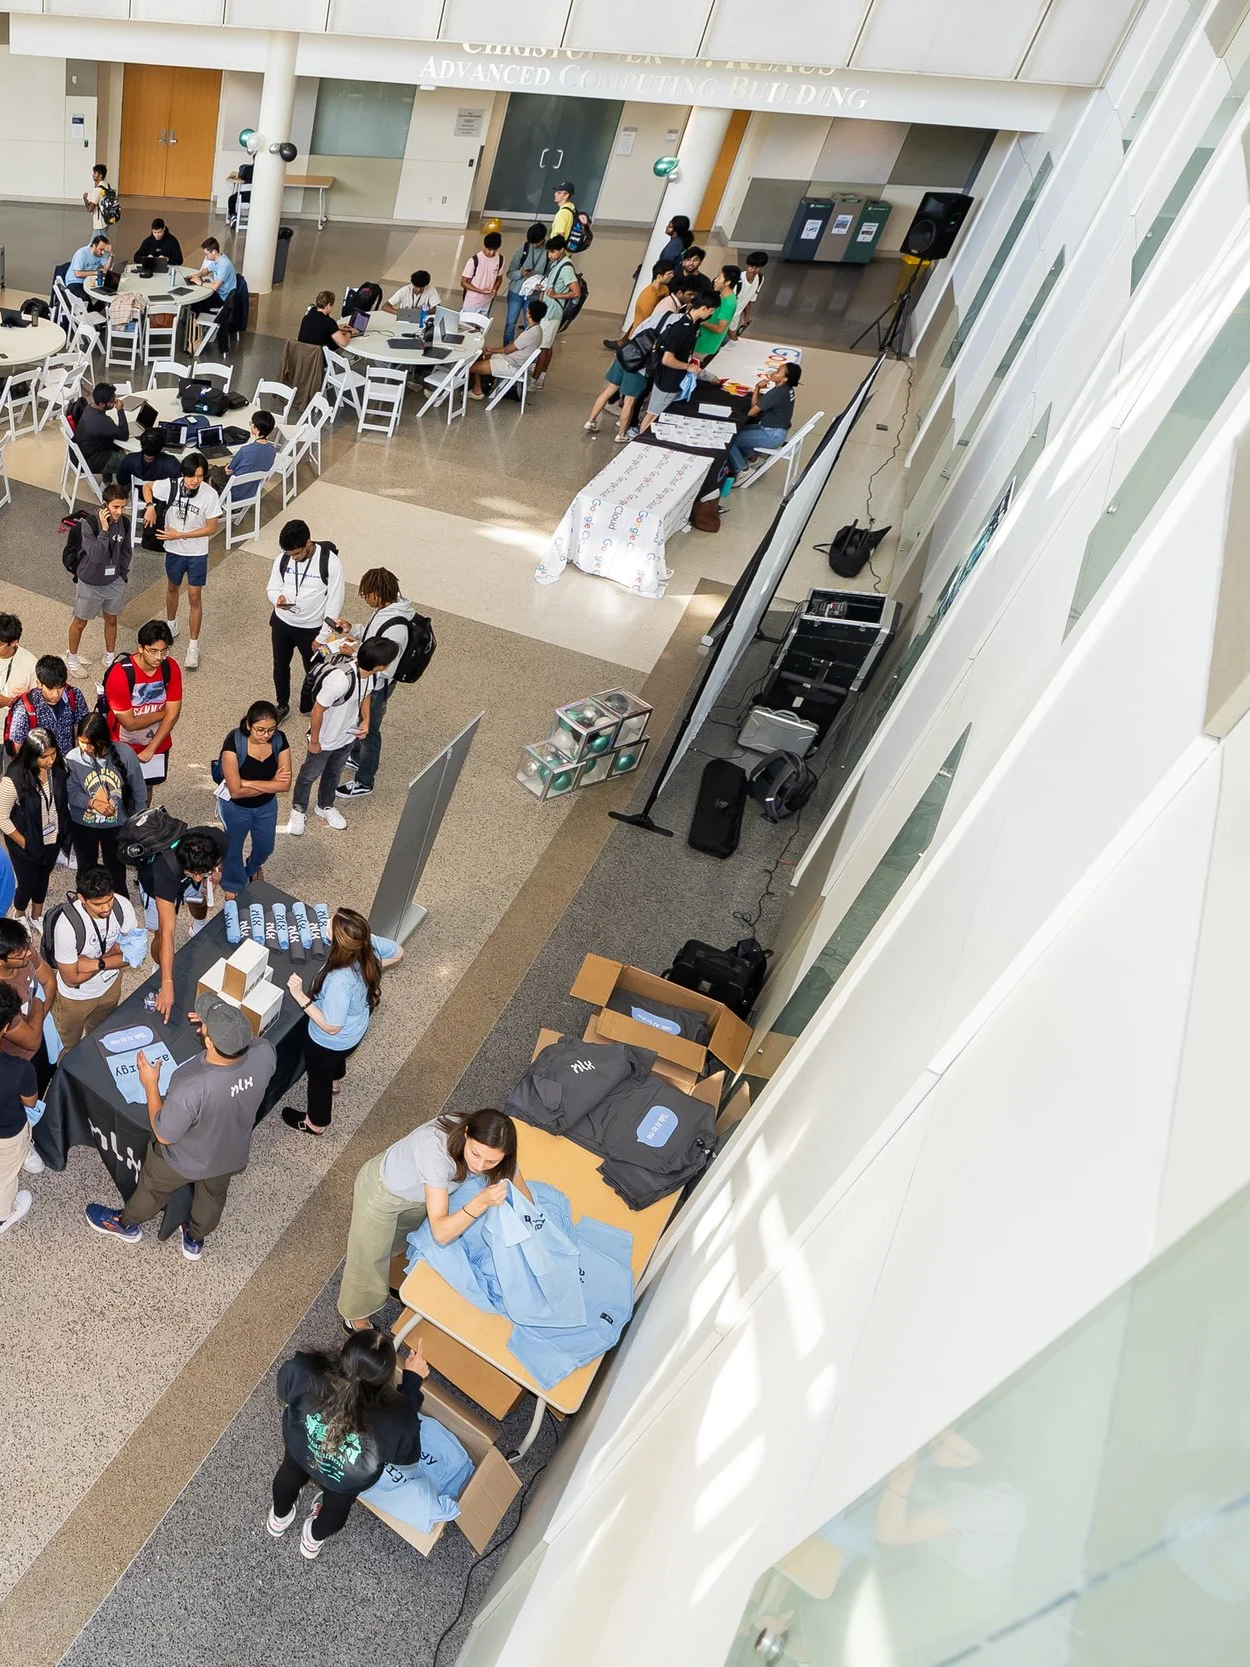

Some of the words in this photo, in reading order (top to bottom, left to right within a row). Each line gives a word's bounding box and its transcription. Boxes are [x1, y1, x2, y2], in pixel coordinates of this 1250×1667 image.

[419, 55, 551, 87] ADVANCED
[558, 64, 720, 97] COMPUTING
[730, 75, 871, 110] BUILDING
[609, 505, 624, 531] Cloud
[630, 510, 649, 541] Google
[100, 768, 121, 789] FLOYD
